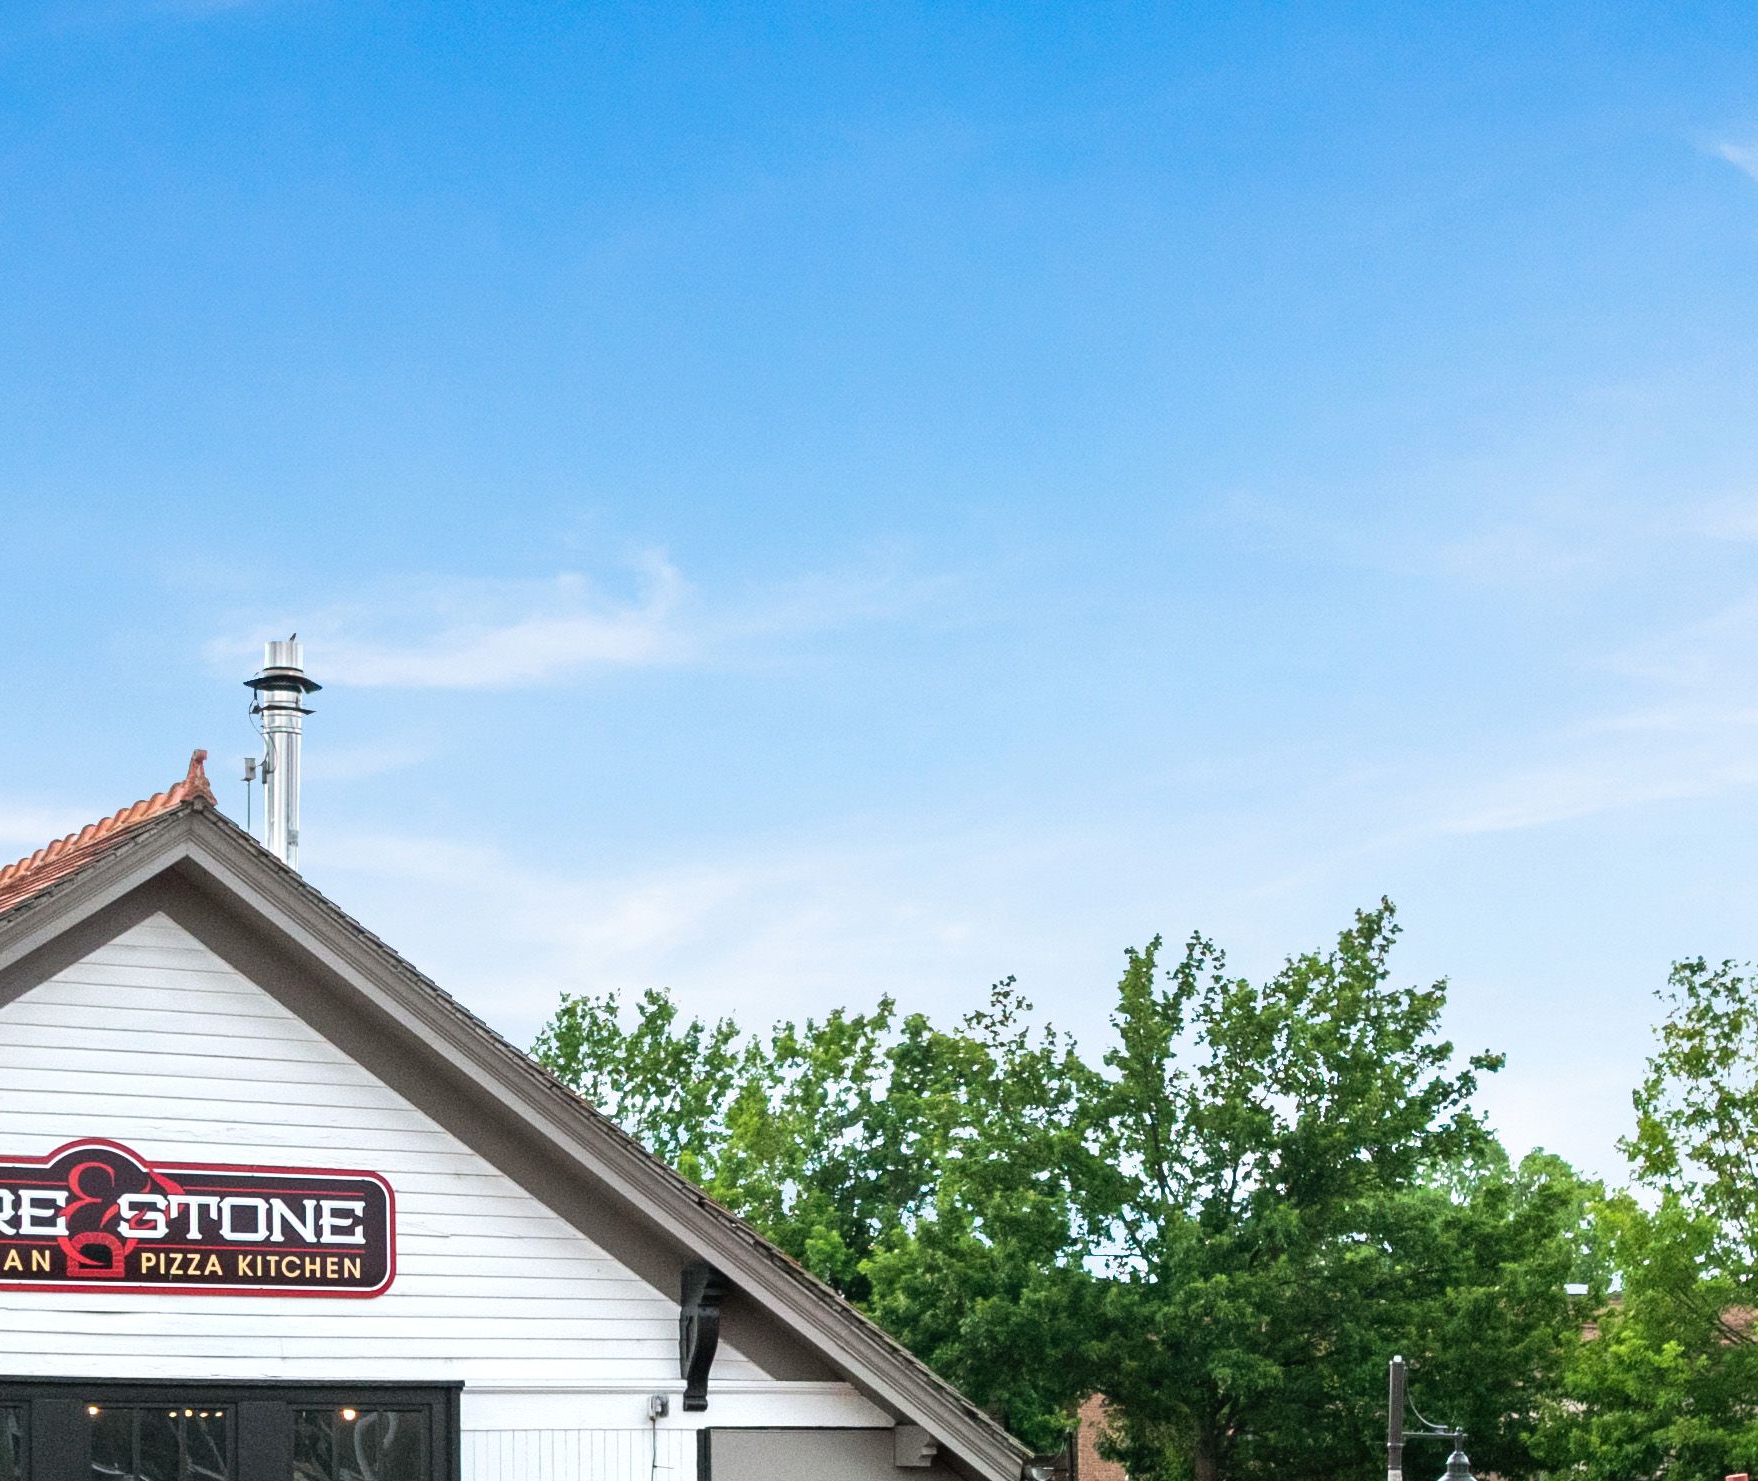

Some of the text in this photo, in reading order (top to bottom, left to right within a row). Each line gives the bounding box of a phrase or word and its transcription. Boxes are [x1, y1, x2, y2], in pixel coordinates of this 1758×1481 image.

[118, 1193, 366, 1244] STONE
[141, 1252, 223, 1277] PIZZA
[237, 1253, 363, 1280] KITCHEN
